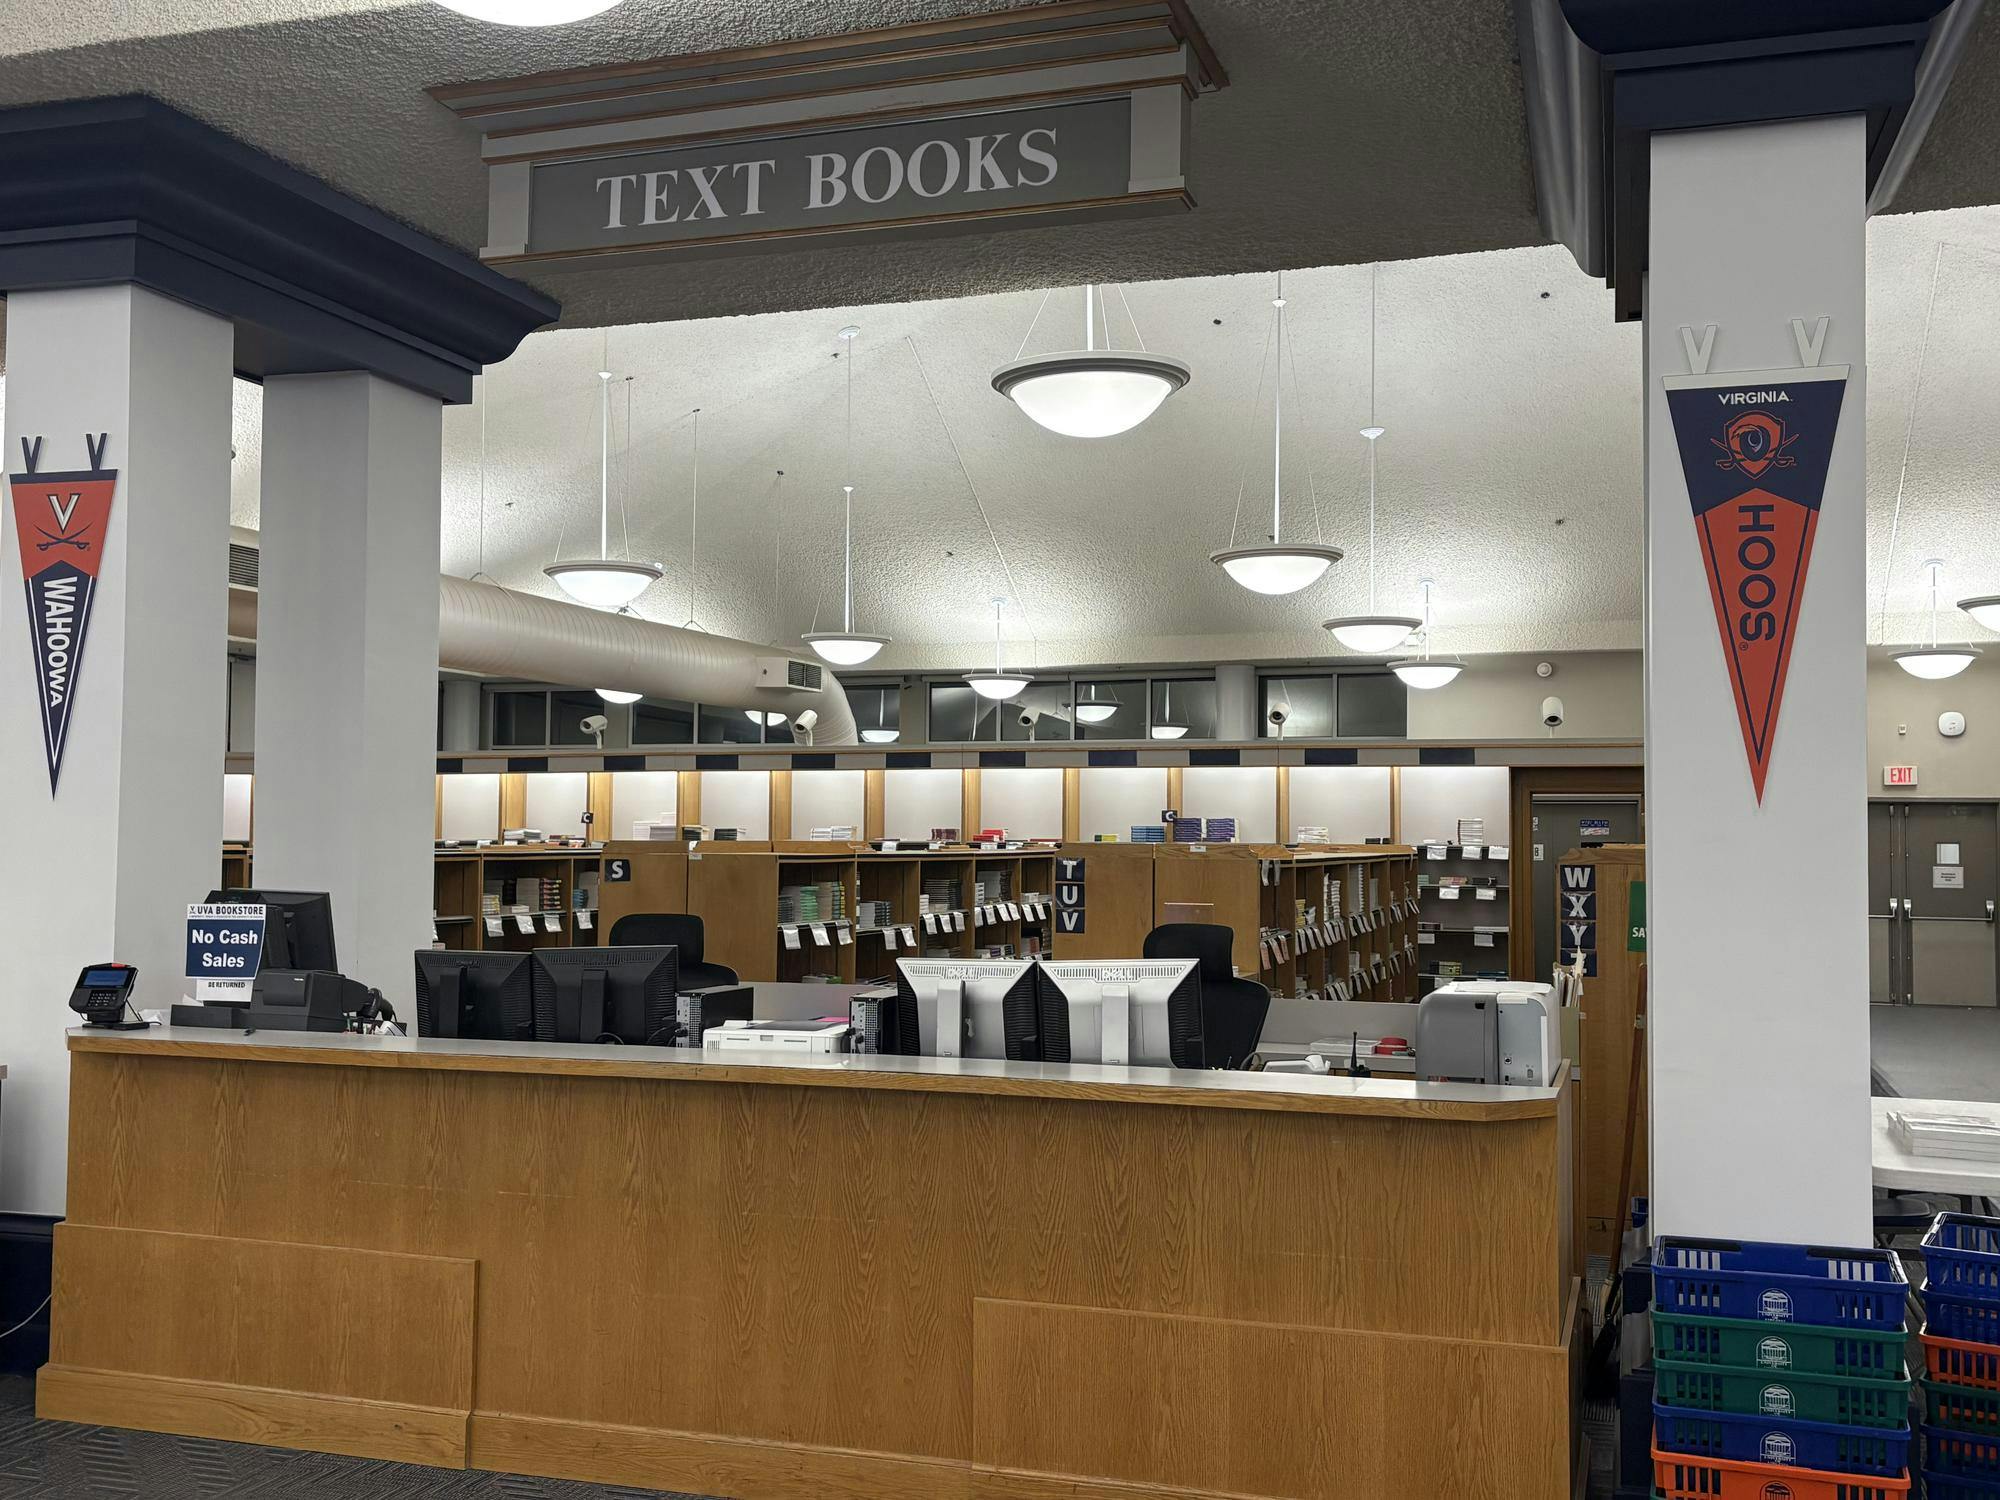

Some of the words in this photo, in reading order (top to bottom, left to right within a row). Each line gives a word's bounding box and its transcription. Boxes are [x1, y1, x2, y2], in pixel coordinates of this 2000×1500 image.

[596, 159, 775, 230] TEXT
[802, 128, 1059, 210] BOOKS
[1717, 391, 1791, 406] VIRGINIA
[1738, 504, 1776, 641] HOOS
[43, 576, 78, 708] WAHOOWA
[1890, 767, 1913, 783] EXIT
[583, 813, 591, 823] C
[611, 860, 624, 878] S
[1062, 860, 1077, 879] T
[1564, 867, 1591, 888] W
[1062, 885, 1078, 905] U
[197, 906, 213, 915] UVA
[216, 906, 264, 915] BOOKSTORE
[1568, 895, 1587, 918] X
[1062, 911, 1079, 931] V
[191, 929, 214, 944] No
[219, 929, 258, 945] Cash
[1569, 924, 1588, 946] Y
[202, 952, 245, 968] Sales
